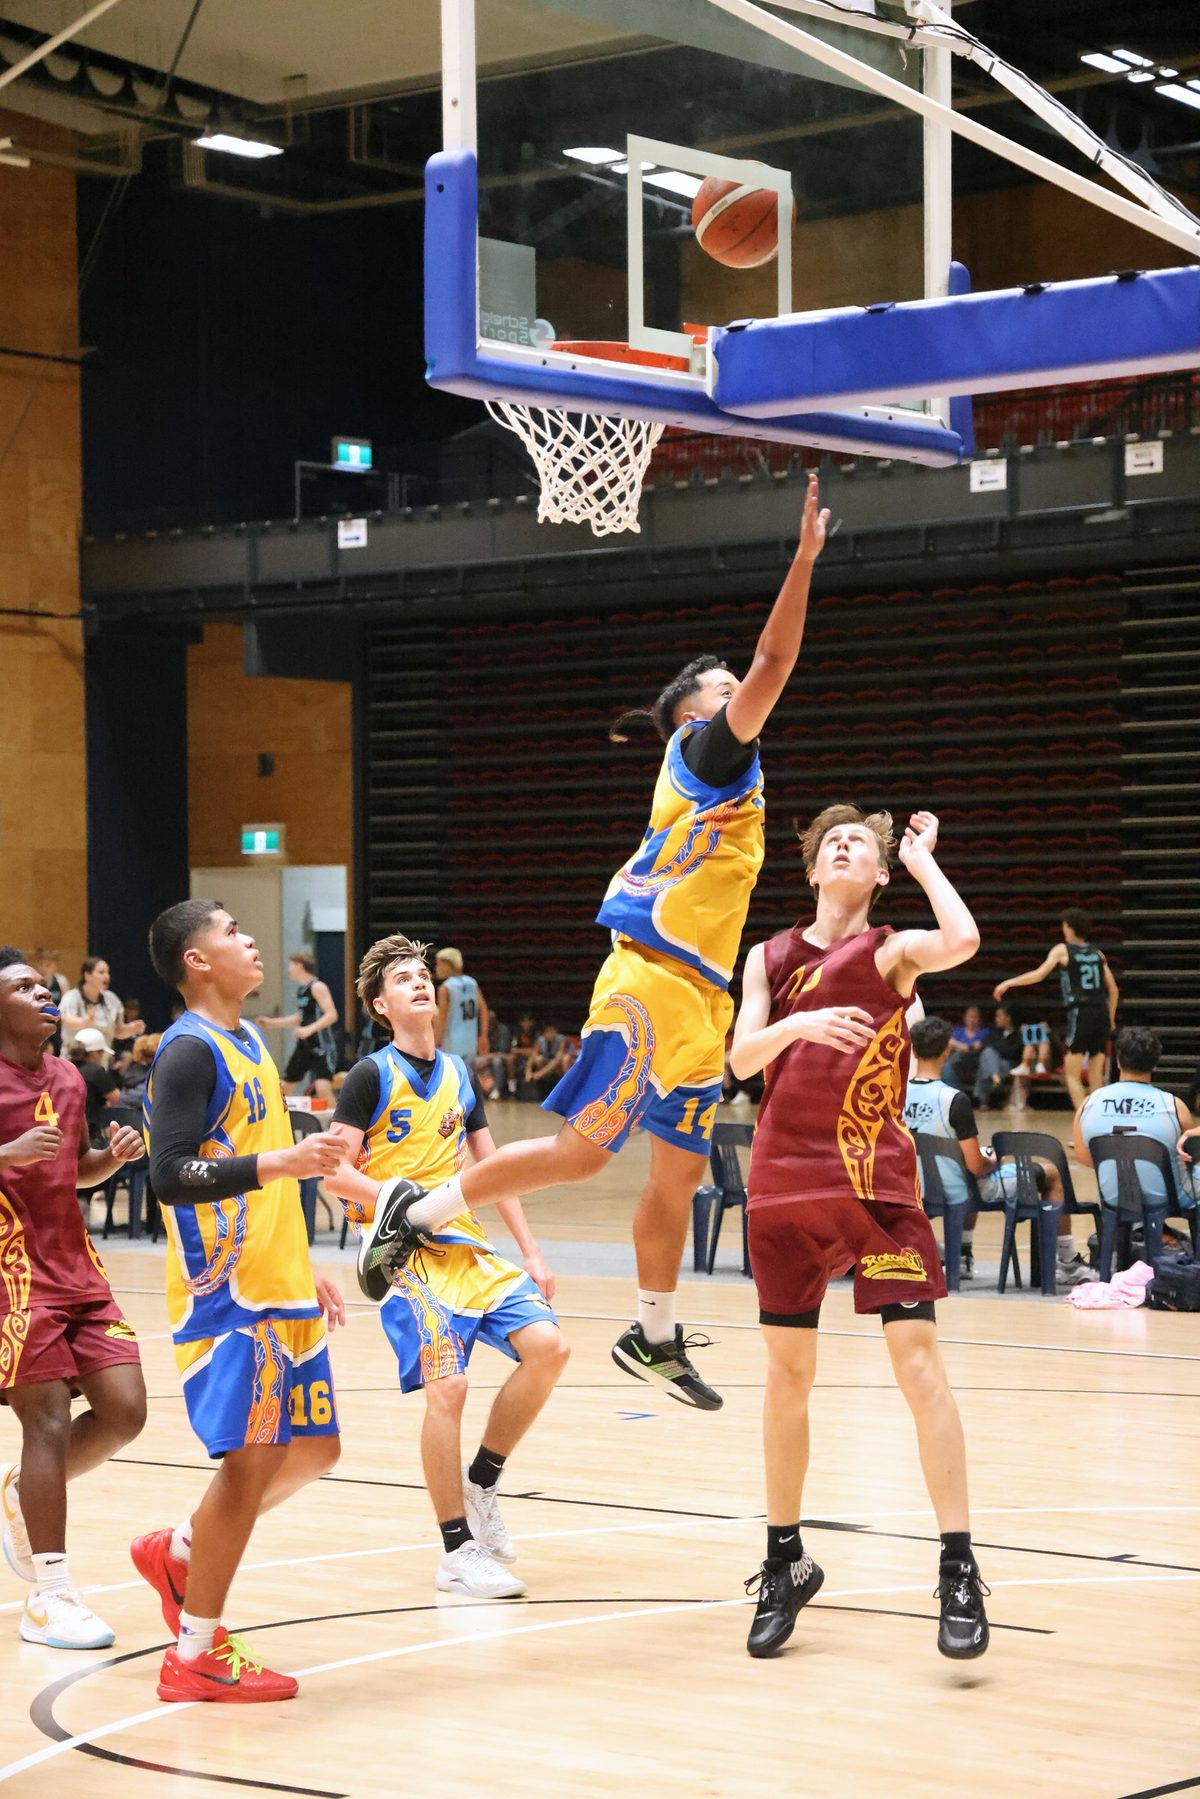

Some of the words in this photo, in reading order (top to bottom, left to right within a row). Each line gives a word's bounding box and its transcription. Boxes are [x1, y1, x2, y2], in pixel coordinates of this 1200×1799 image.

[1080, 964, 1100, 989] 21
[460, 999, 475, 1021] 10
[34, 1091, 60, 1127] 4
[243, 1077, 266, 1124] 16
[675, 1097, 718, 1140] 14
[386, 1109, 412, 1143] 5
[287, 1380, 332, 1426] 16
